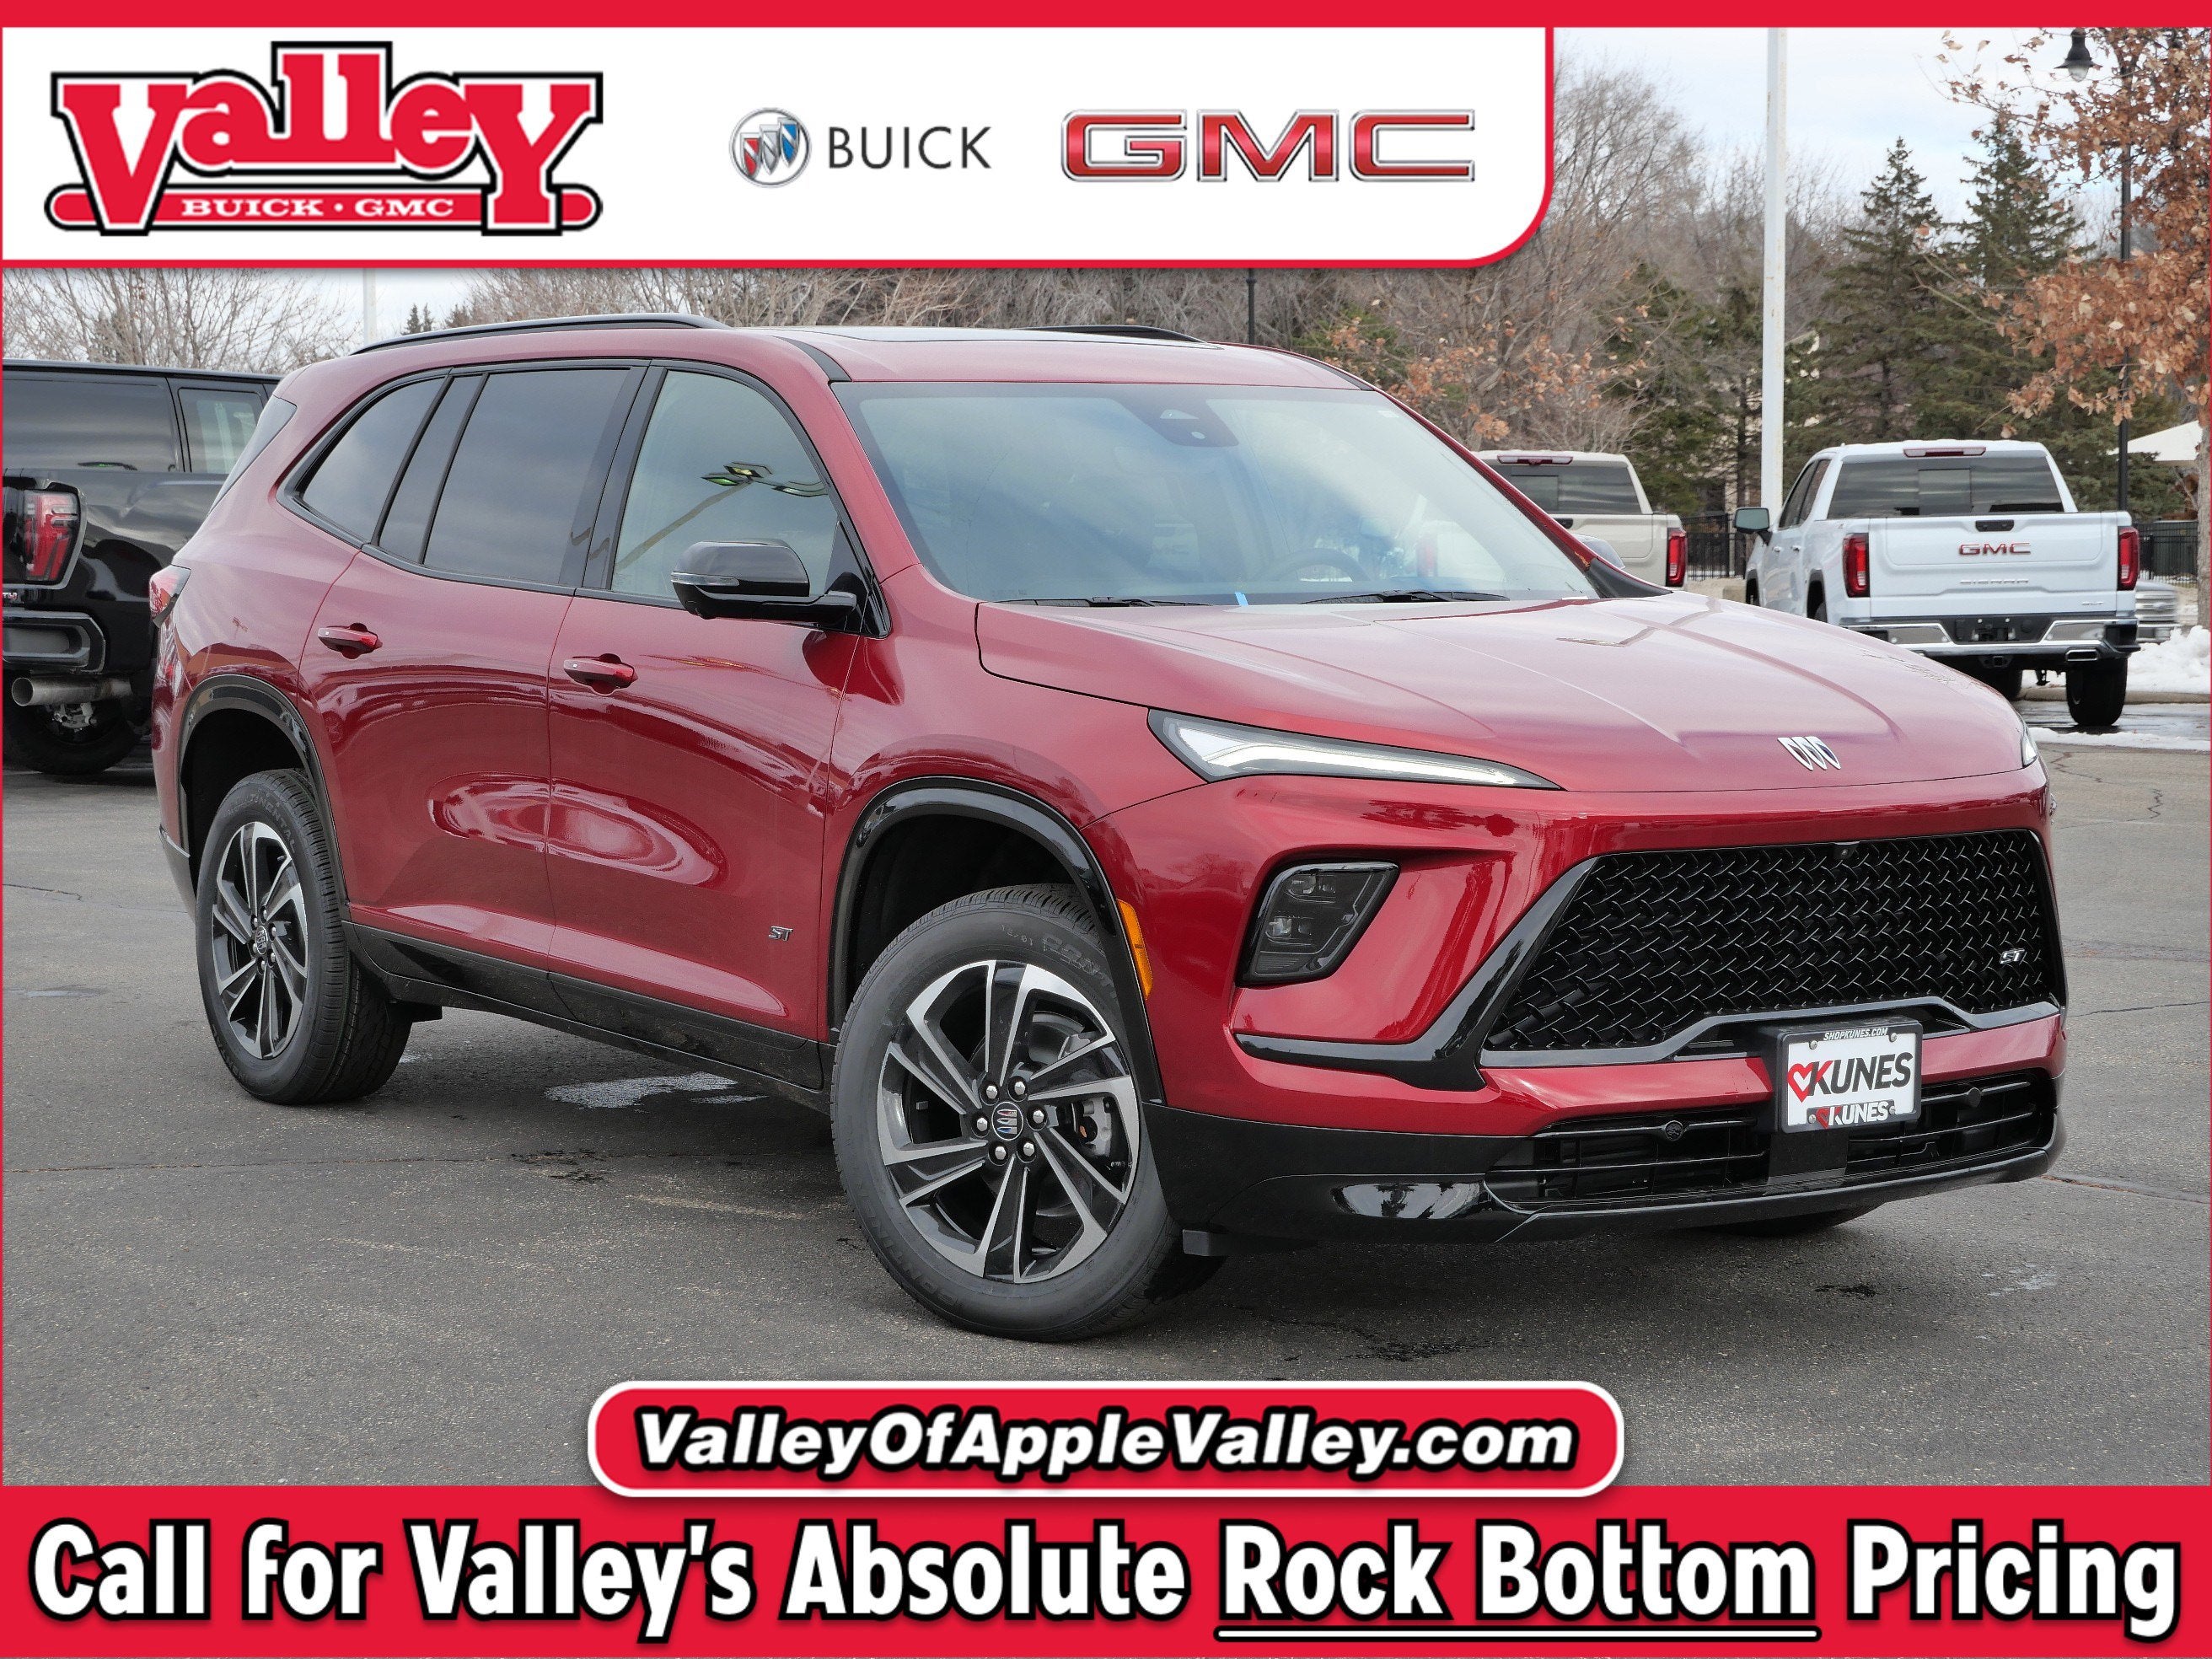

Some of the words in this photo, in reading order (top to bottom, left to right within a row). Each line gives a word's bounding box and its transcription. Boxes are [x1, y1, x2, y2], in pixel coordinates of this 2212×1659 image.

[1959, 542, 2031, 556] GMC
[768, 926, 794, 942] ST
[1823, 1027, 1888, 1041] SHOPKUNES.COM
[1806, 1051, 1914, 1097] KUNES
[1827, 1100, 1889, 1126] KUNES
